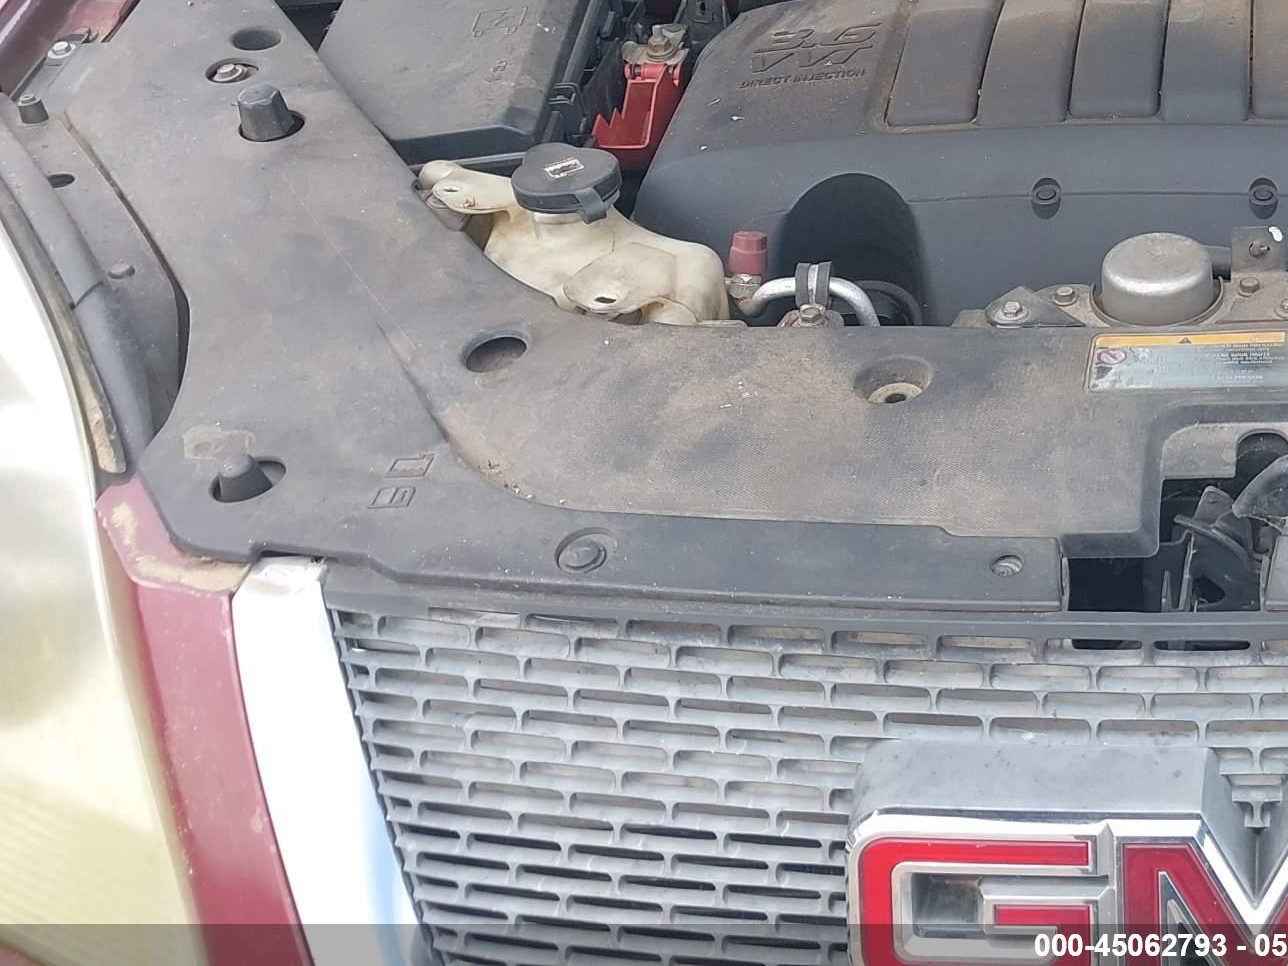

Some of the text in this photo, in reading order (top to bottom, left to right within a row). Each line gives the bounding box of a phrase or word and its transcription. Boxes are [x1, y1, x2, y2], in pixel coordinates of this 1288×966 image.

[753, 22, 883, 54] 3.6
[738, 68, 866, 89] DIRECT INJECTION
